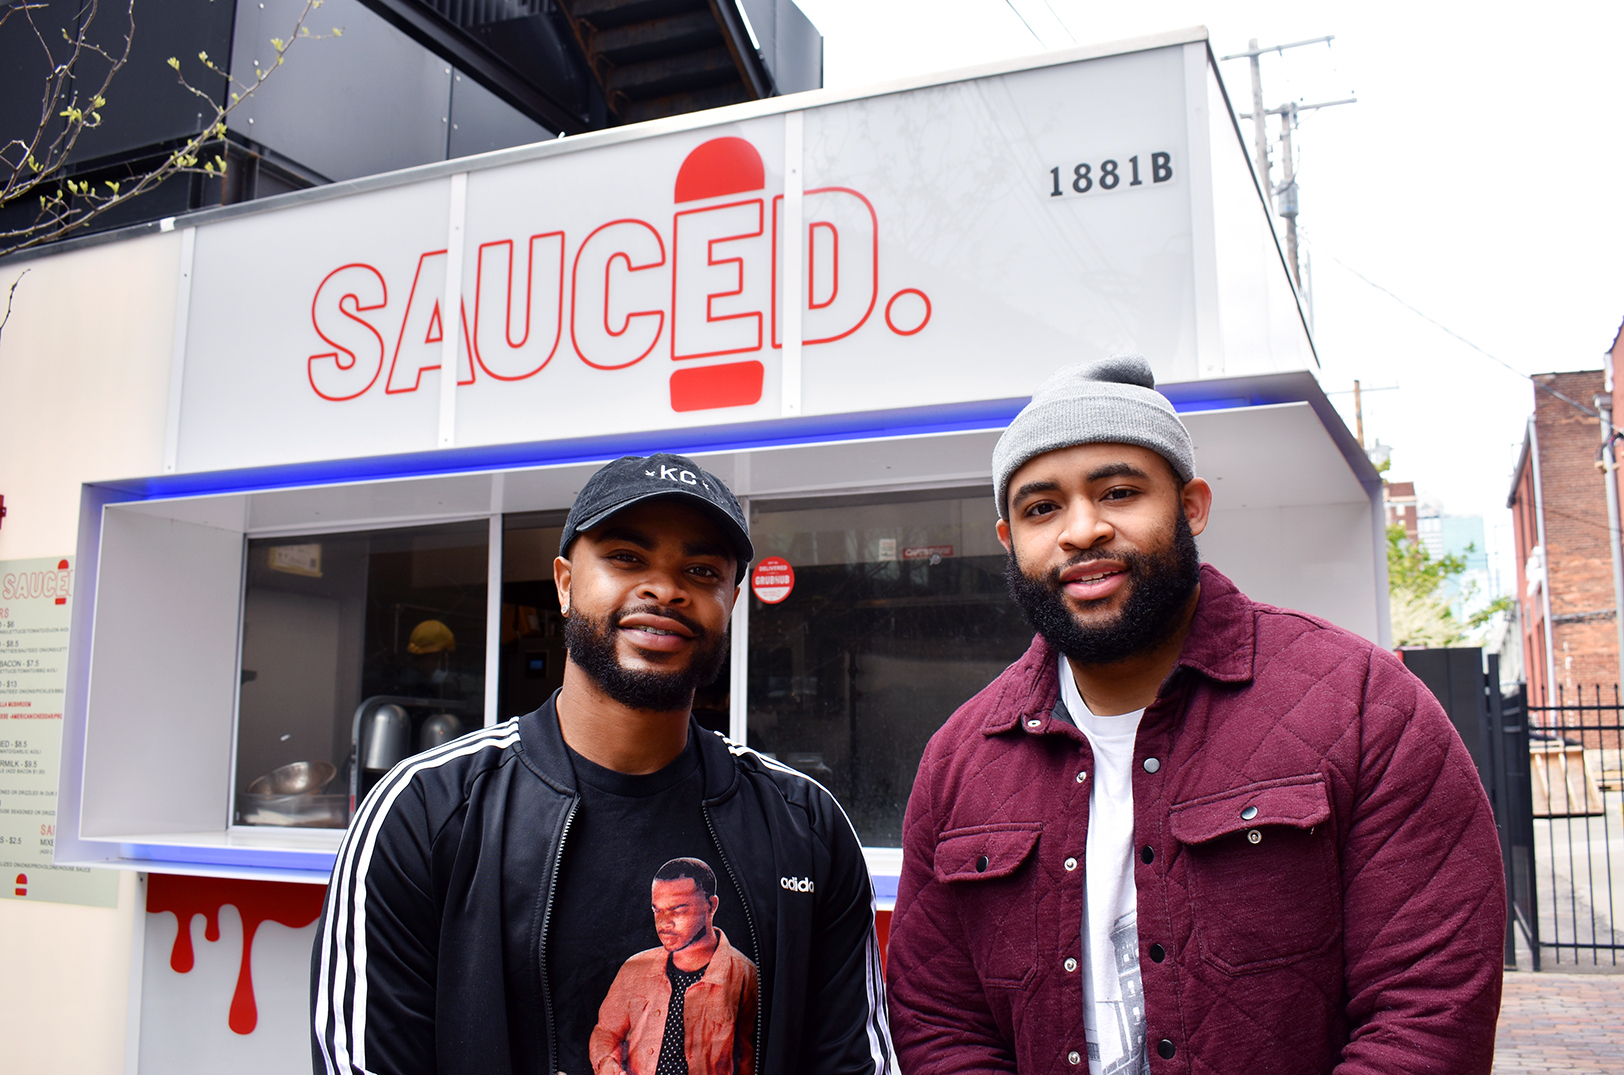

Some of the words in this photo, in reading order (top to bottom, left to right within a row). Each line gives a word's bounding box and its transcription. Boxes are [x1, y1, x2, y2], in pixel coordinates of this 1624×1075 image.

[1050, 151, 1173, 197] 1881B
[307, 185, 933, 402] SAUCED.
[660, 464, 697, 486] KC
[755, 574, 791, 586] GRUBHUB
[780, 876, 815, 893] adida
